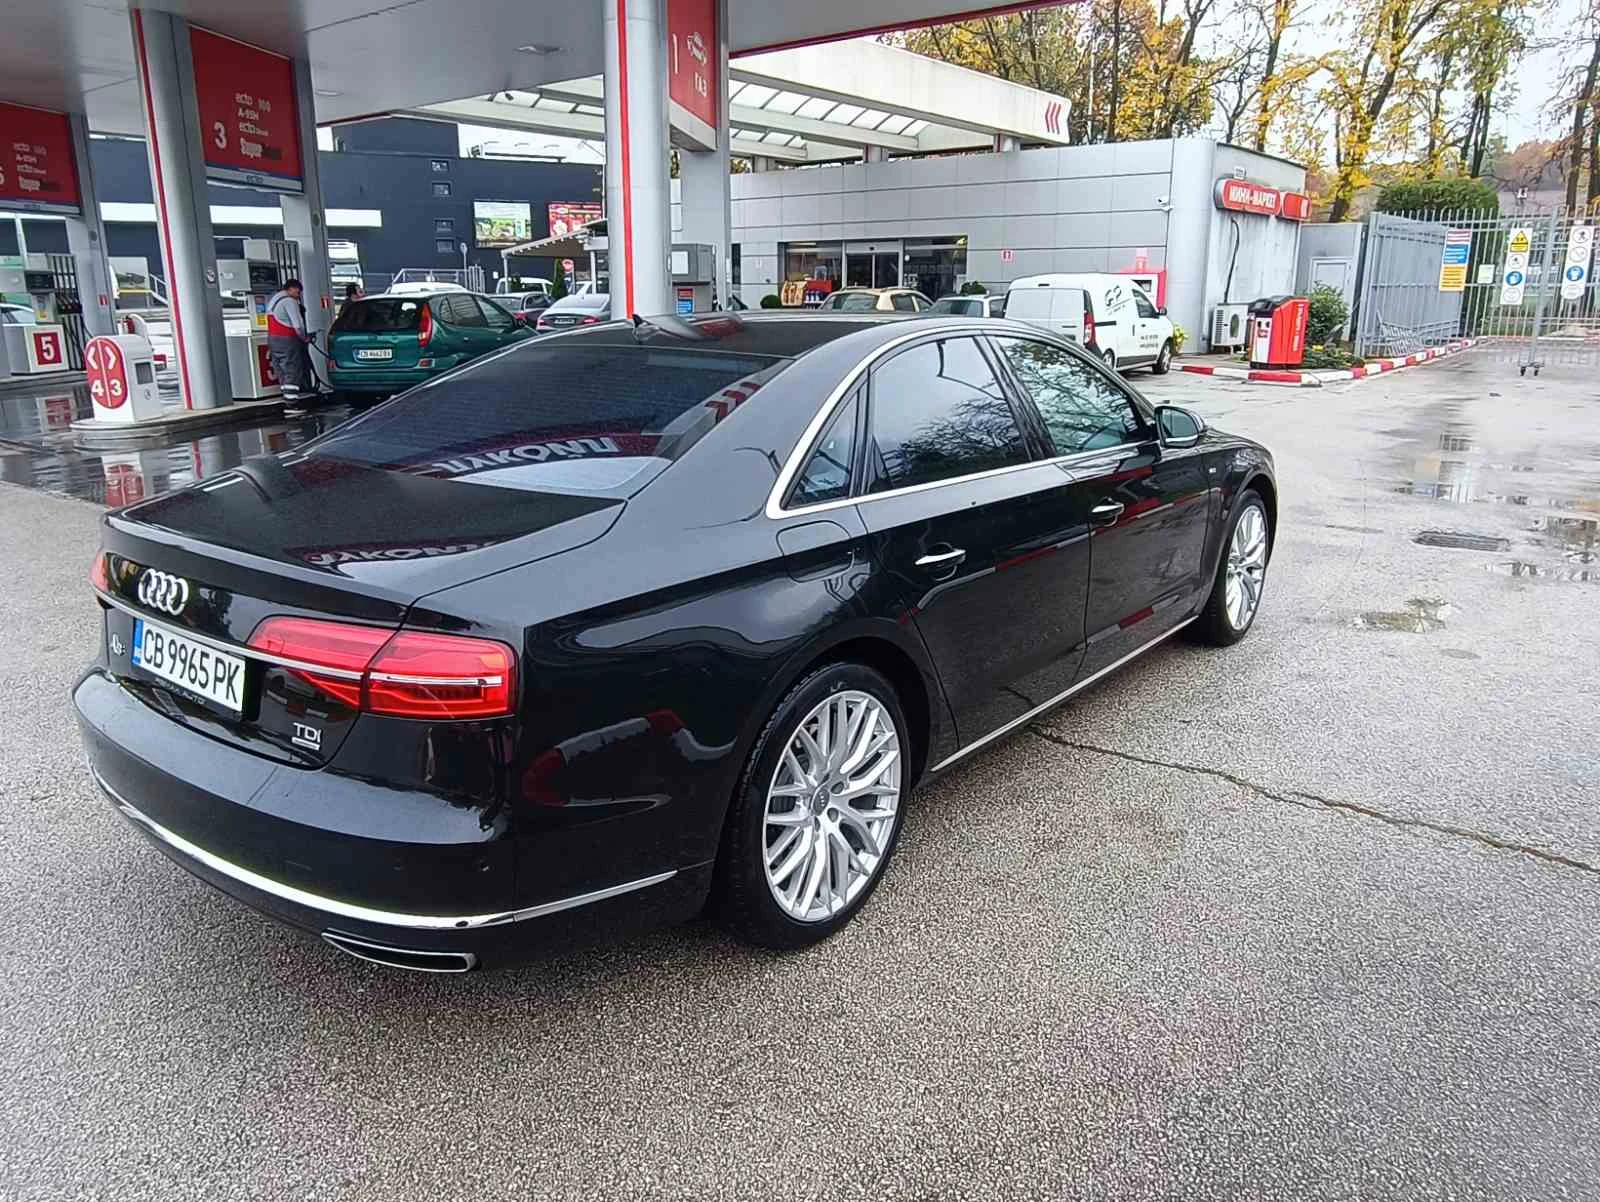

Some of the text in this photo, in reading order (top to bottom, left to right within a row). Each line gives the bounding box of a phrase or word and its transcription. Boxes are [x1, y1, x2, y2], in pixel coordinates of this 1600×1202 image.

[213, 121, 228, 150] 3
[40, 335, 55, 361] 5
[91, 379, 122, 397] 4 3
[143, 628, 164, 669] CB
[168, 638, 209, 690] 9965
[212, 656, 241, 704] PK
[292, 721, 321, 743] TDI
